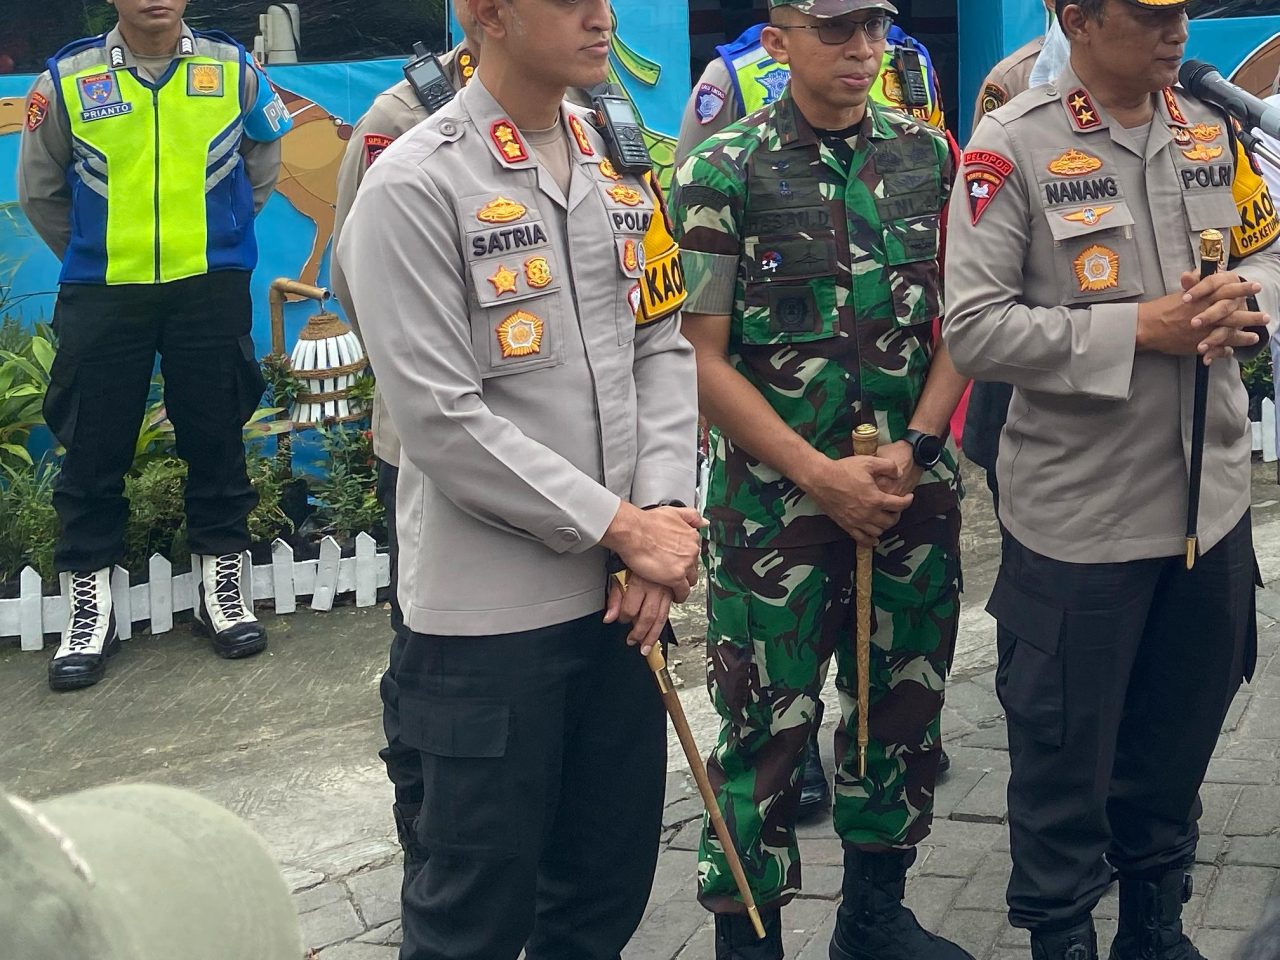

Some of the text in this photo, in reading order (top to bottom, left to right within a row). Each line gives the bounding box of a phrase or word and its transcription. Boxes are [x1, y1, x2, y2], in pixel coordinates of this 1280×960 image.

[83, 103, 130, 120] PRIANTO
[966, 153, 1010, 172] PELOPOR
[1045, 177, 1118, 204] NANANG
[1181, 165, 1231, 190] POLRI
[1240, 185, 1276, 234] KAO
[472, 224, 547, 256] SATRIA
[1241, 229, 1259, 249] OPS
[645, 253, 686, 307] KAO
